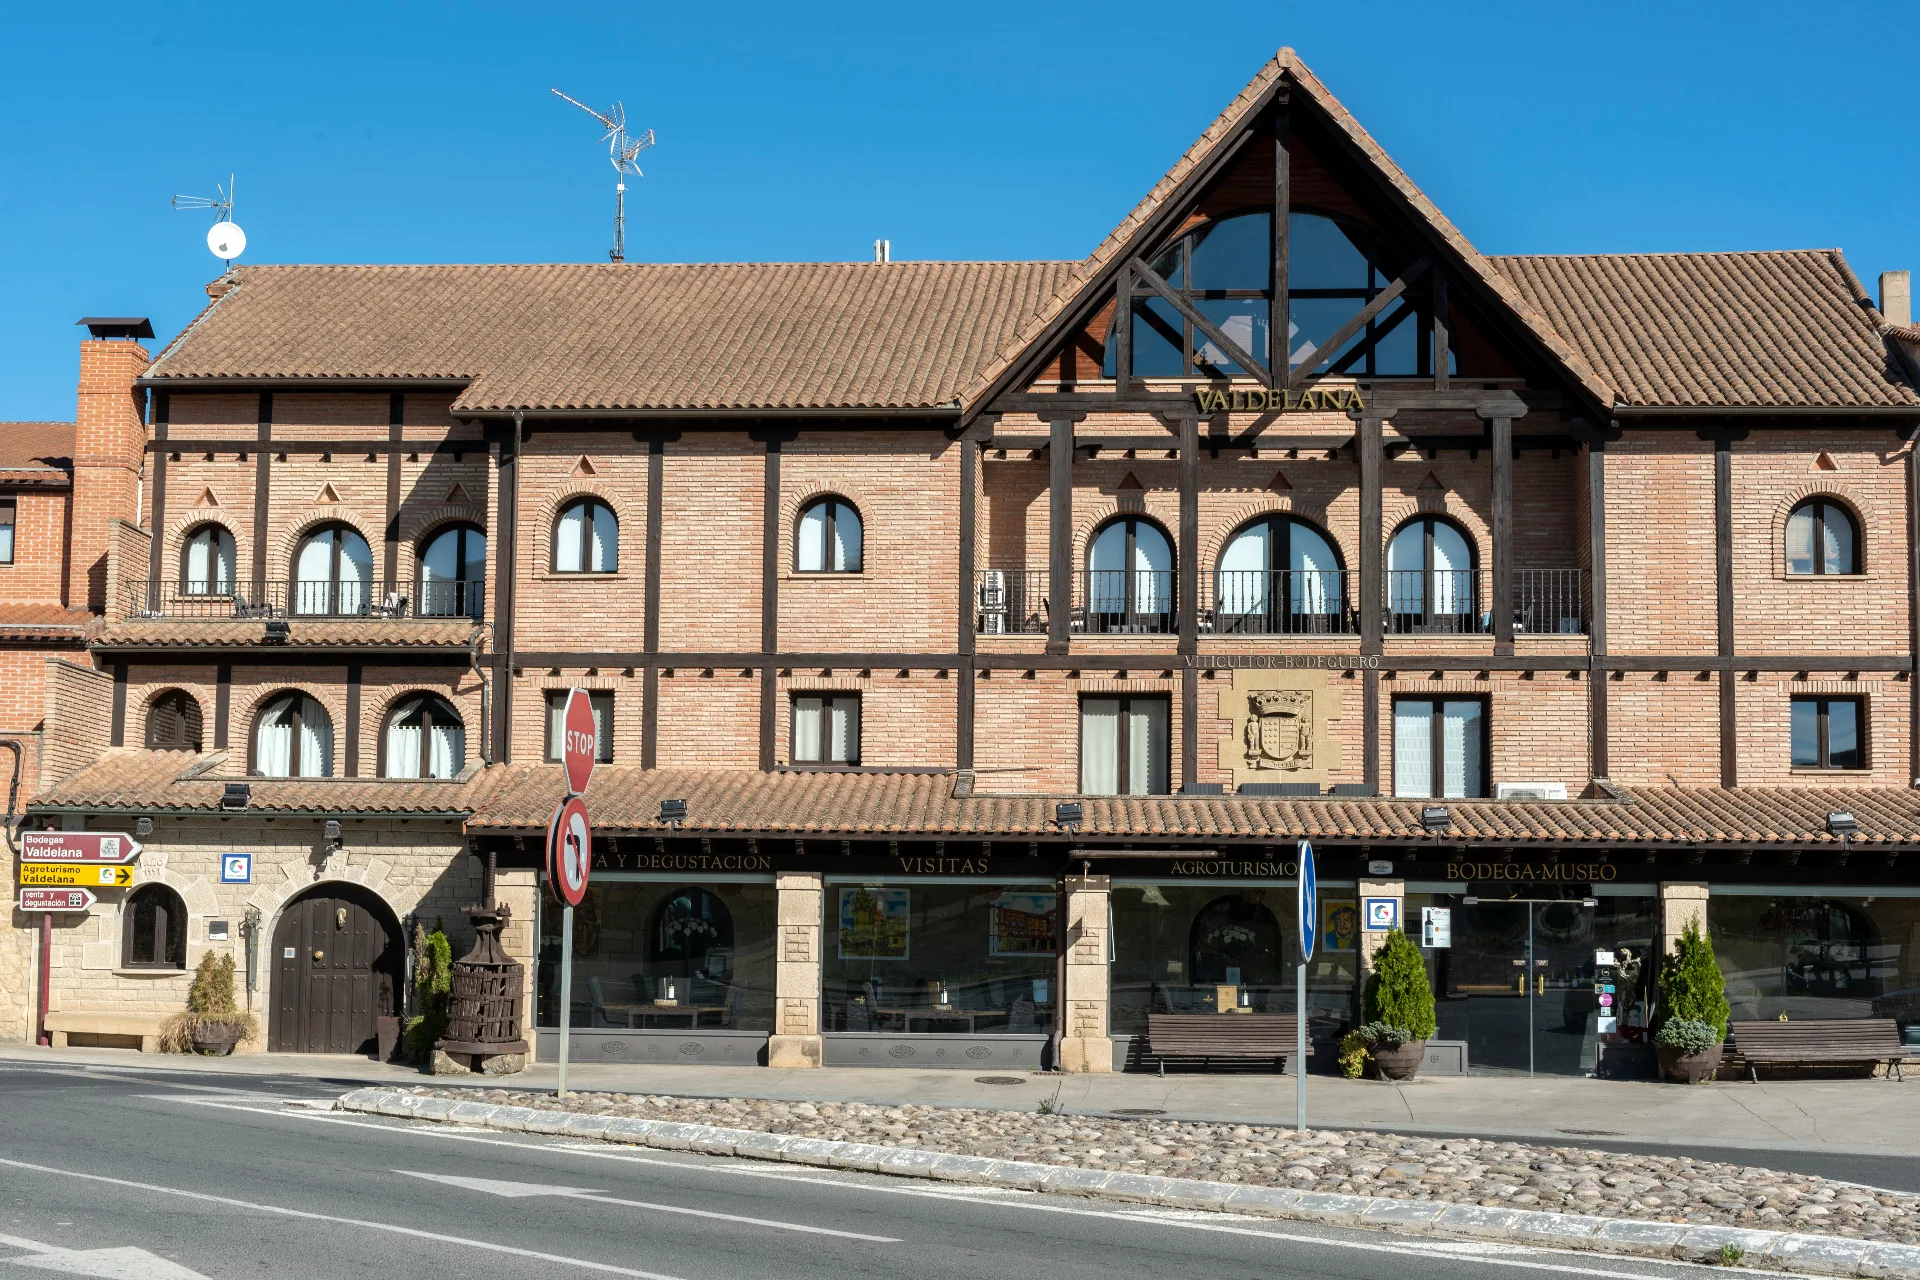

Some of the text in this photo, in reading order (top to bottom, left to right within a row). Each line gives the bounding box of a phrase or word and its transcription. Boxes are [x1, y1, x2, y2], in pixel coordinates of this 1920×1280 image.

[1195, 388, 1366, 411] VALDELANA
[566, 729, 594, 756] STOP
[26, 835, 64, 845] Bodegas
[25, 846, 83, 858] Valdelana
[617, 854, 627, 868] Y
[637, 854, 771, 870] DEGUSTACION
[900, 858, 989, 874] VISITAS
[1171, 860, 1298, 876] AGROTURISMO
[23, 865, 81, 874] Agroturismo
[23, 875, 75, 884] Valdelana
[49, 891, 55, 900] y
[24, 899, 66, 907] degustación
